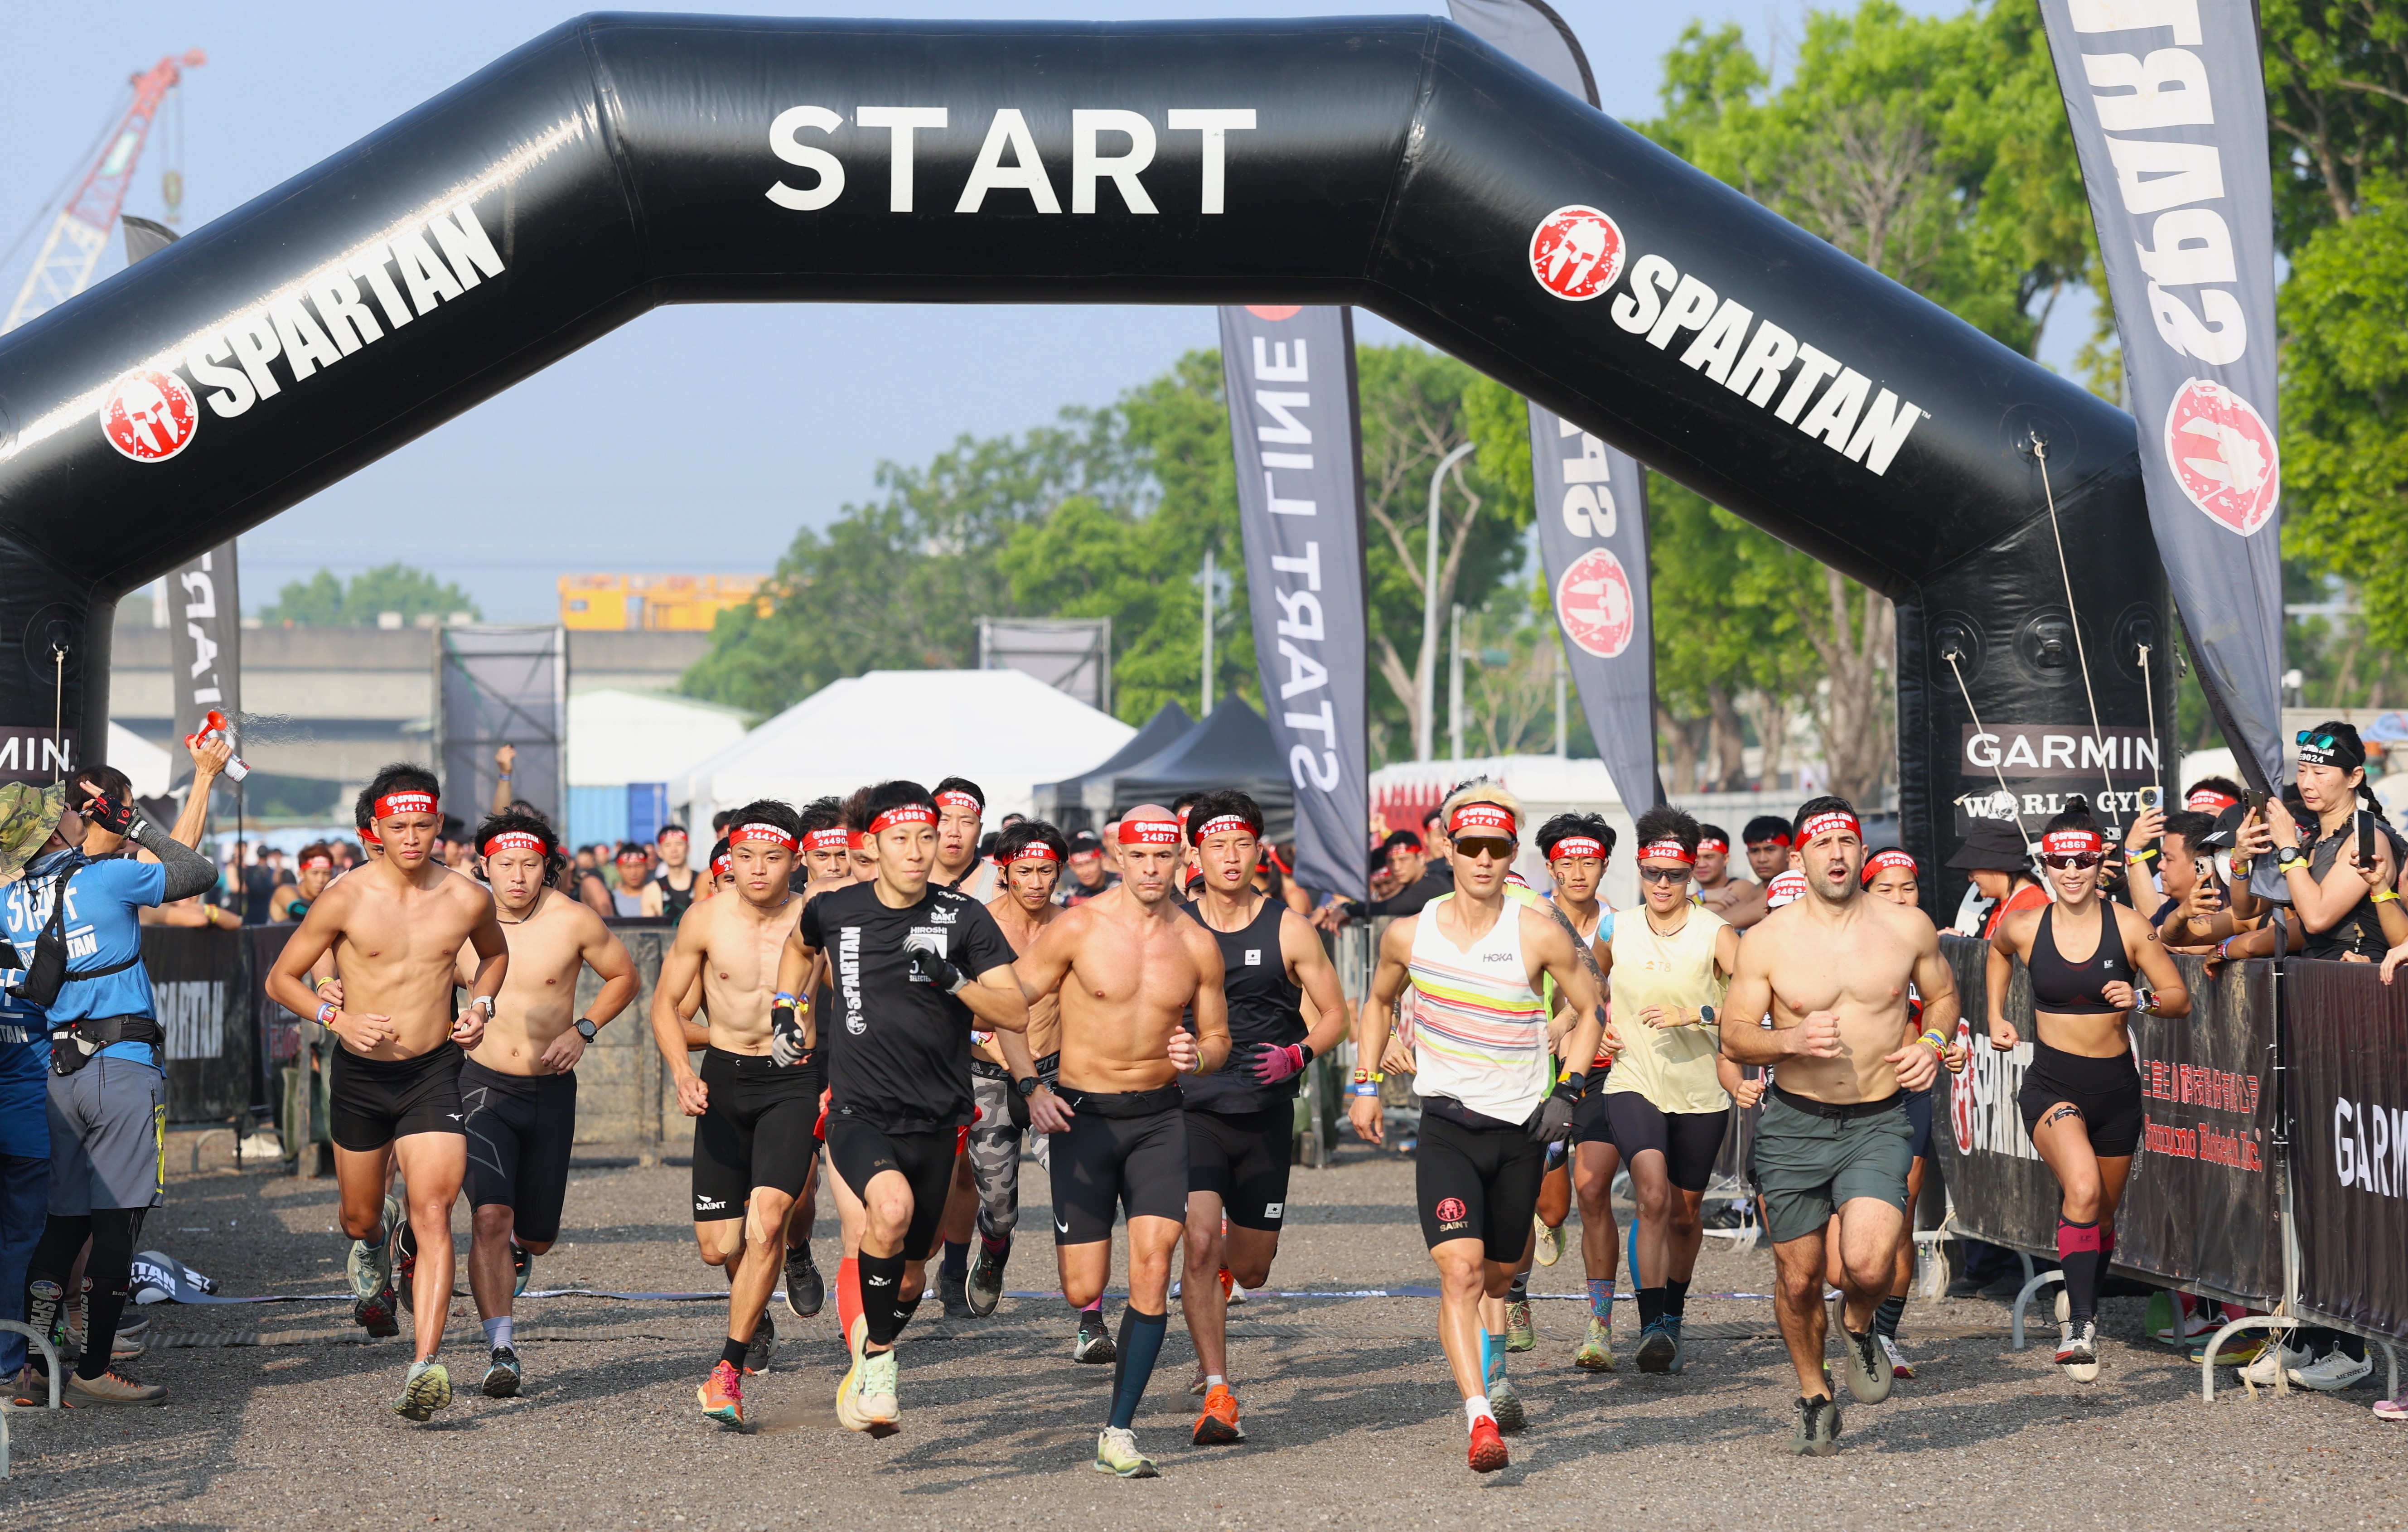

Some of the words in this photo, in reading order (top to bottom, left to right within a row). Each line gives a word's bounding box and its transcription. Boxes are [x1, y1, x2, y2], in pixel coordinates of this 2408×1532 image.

[764, 105, 1257, 214] START
[186, 206, 506, 419] SPARTAN
[1610, 254, 1922, 477] SPARTAN
[1966, 733, 2159, 770] GARMIN
[396, 794, 431, 804] SPARTAN
[392, 803, 427, 814] 24412
[892, 803, 933, 814] ARTAN
[1468, 807, 1507, 820] SPARTAN
[889, 811, 926, 824] 24986
[1462, 817, 1500, 826] 24747
[1812, 812, 1853, 826] SPARTAN
[752, 823, 792, 841] SPARTAN
[1148, 823, 1178, 833] SPARTAN
[1204, 822, 1237, 838] 24761
[1810, 821, 1846, 838] 24998
[505, 832, 540, 844] SPARTAN
[746, 831, 783, 845] 24447
[817, 837, 846, 846] 24490
[1142, 833, 1175, 842] 24872
[2058, 831, 2093, 841] SPARTAN
[501, 841, 532, 850] 24411
[1025, 841, 1050, 851] ARTAN
[1568, 839, 1600, 850] SPARTAN
[2054, 841, 2086, 851] 24869
[1564, 847, 1594, 855] 24987
[1649, 849, 1678, 857] 24428
[1882, 858, 1912, 867] 24699
[1885, 853, 1915, 864] SPARTAN
[930, 912, 957, 921] SAINT
[1482, 953, 1513, 962] HOKA
[840, 927, 862, 1010] SPARTAN
[1658, 961, 1671, 972] T8
[696, 1201, 726, 1210] SAINT
[1440, 1221, 1470, 1232] SAINT
[868, 1278, 892, 1286] SAINT
[2335, 1366, 2369, 1380] MERRELL
